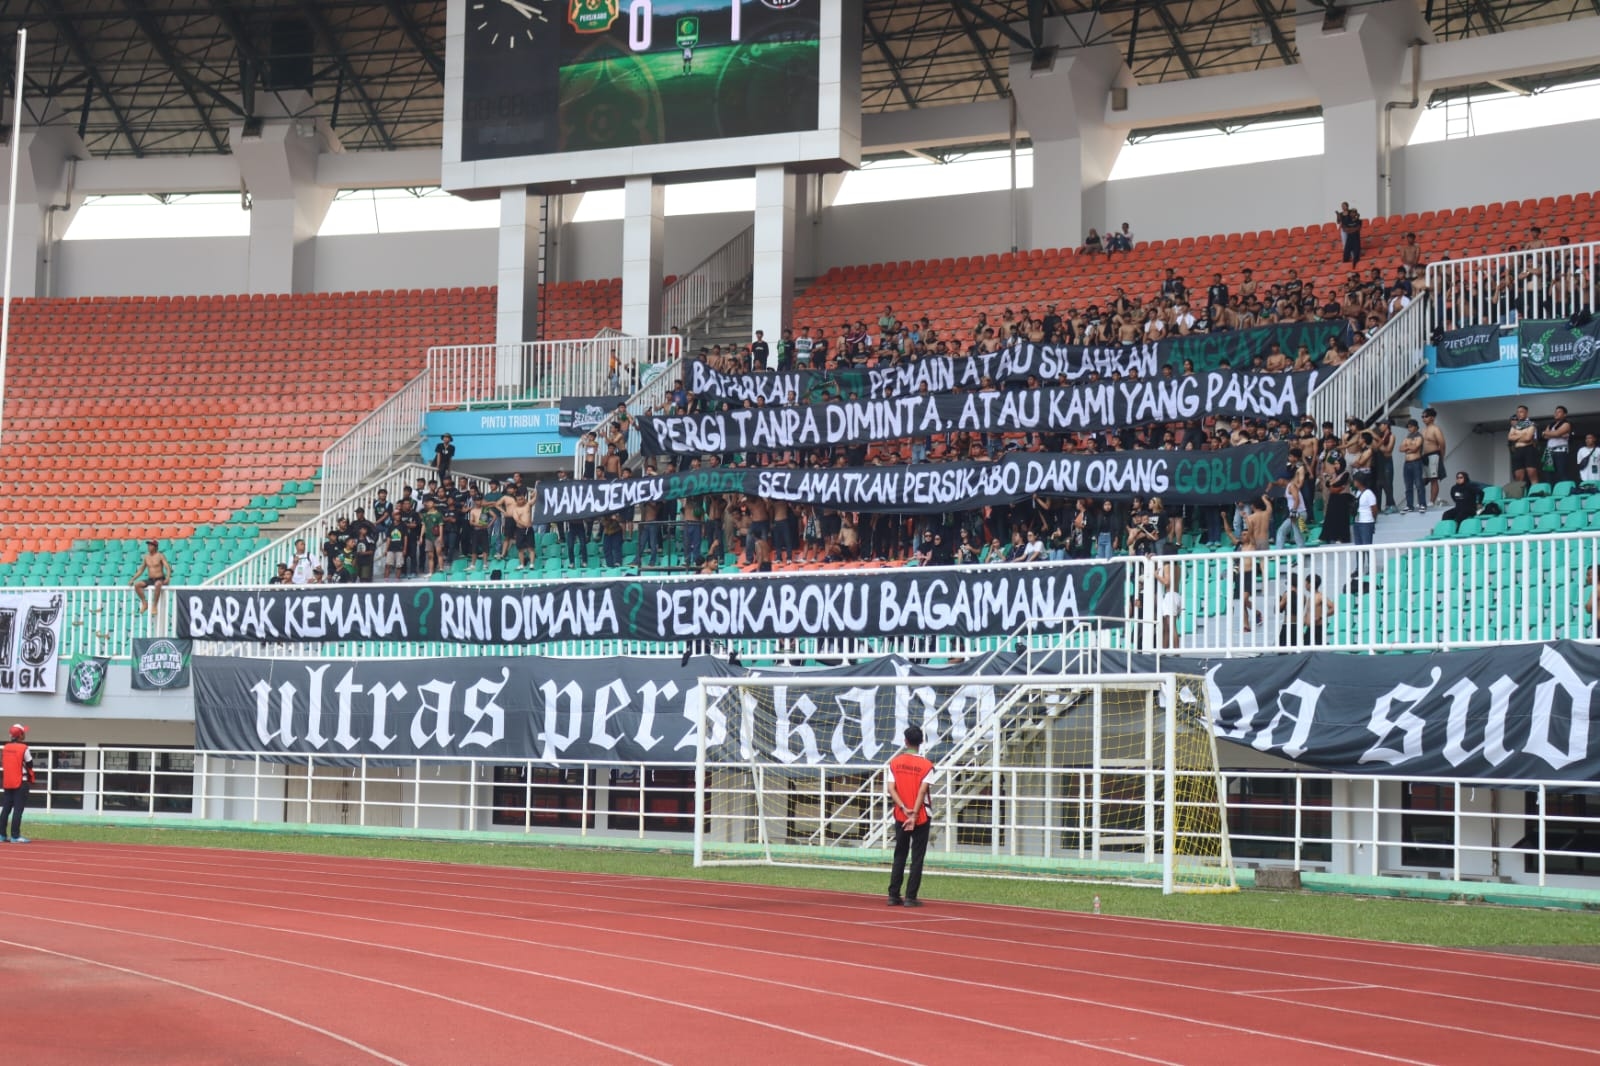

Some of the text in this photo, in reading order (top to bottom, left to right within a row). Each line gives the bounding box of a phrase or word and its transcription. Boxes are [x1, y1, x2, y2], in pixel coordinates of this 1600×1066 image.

[628, 0, 652, 51] 0
[868, 355, 955, 399] PEMAIN
[960, 344, 1034, 386] ATAU
[1039, 342, 1158, 380] SILAHKAN
[1167, 328, 1271, 374] ANGKAT
[481, 415, 506, 429] PINTU
[508, 414, 540, 428] TRIBUN
[653, 414, 725, 452] PERGI
[732, 406, 820, 448] TANPA
[959, 390, 1040, 430] ATAU
[1049, 383, 1115, 428] KAMI
[1120, 375, 1199, 425] YANG
[1205, 372, 1299, 418] PAKSA
[538, 443, 561, 454] EXIT
[543, 451, 1275, 516] MANAJEMEN BOBROK SELAMATKAN PERSIKABO DARI ORANG GOBLOK
[188, 592, 282, 638] BAPAK
[284, 592, 408, 638] KEMANA
[440, 593, 492, 641] RINI
[501, 588, 619, 641] DIMANA
[656, 581, 869, 637] PERSIKABOKU
[879, 573, 1080, 633] BAGAIMANA
[250, 663, 510, 751] ultras
[1358, 644, 1599, 770] sud
